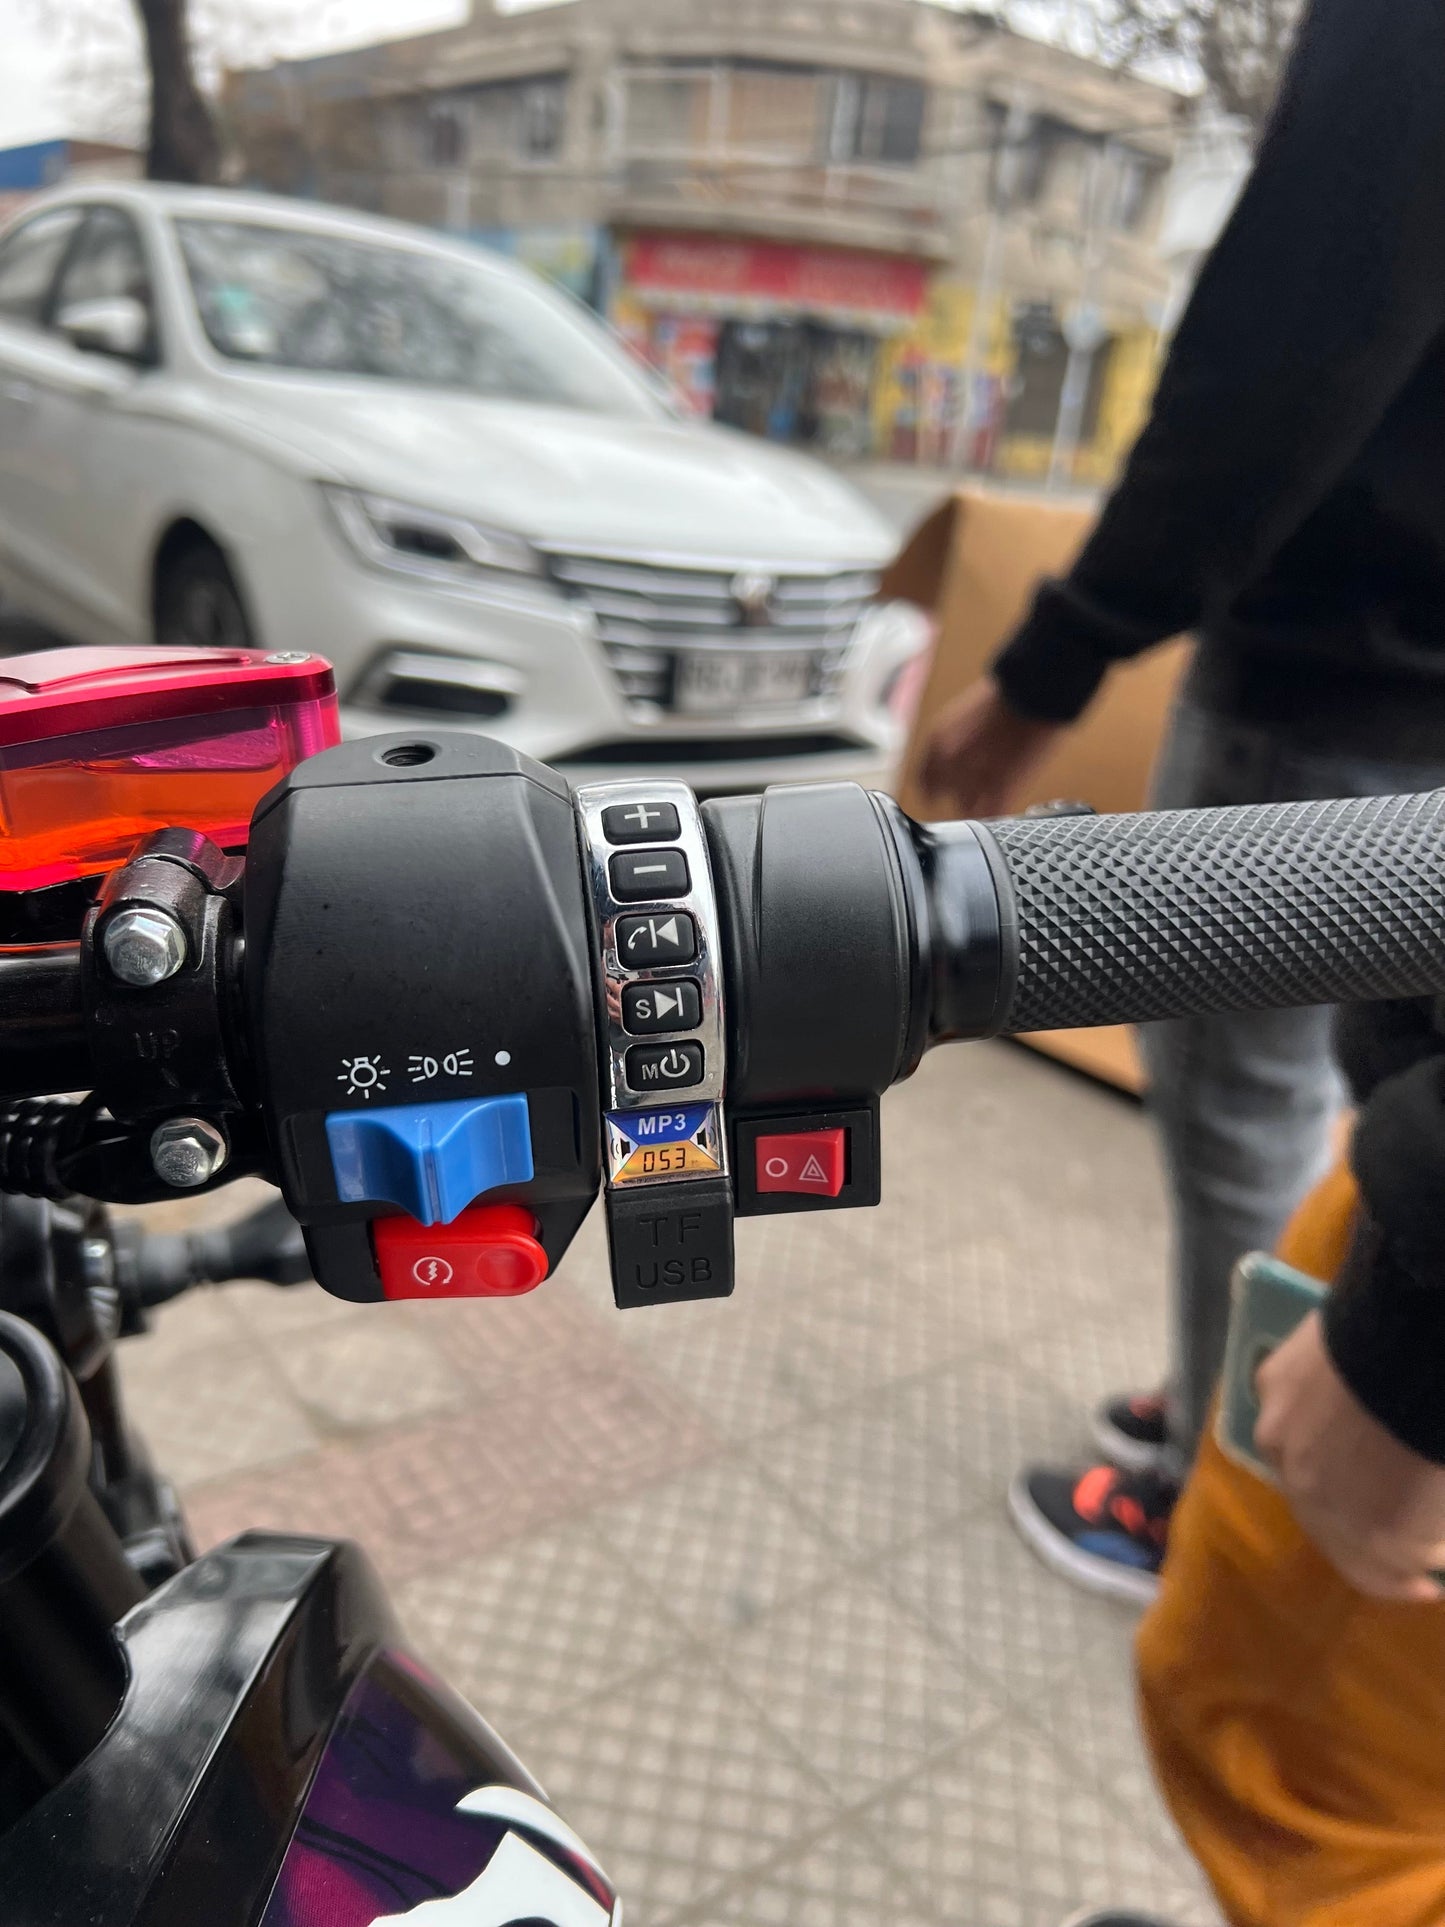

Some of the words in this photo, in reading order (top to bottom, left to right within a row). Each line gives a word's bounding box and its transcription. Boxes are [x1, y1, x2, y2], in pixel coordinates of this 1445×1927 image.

[638, 1113, 687, 1136] MP3
[643, 1147, 686, 1173] 053
[635, 1257, 713, 1291] USB
